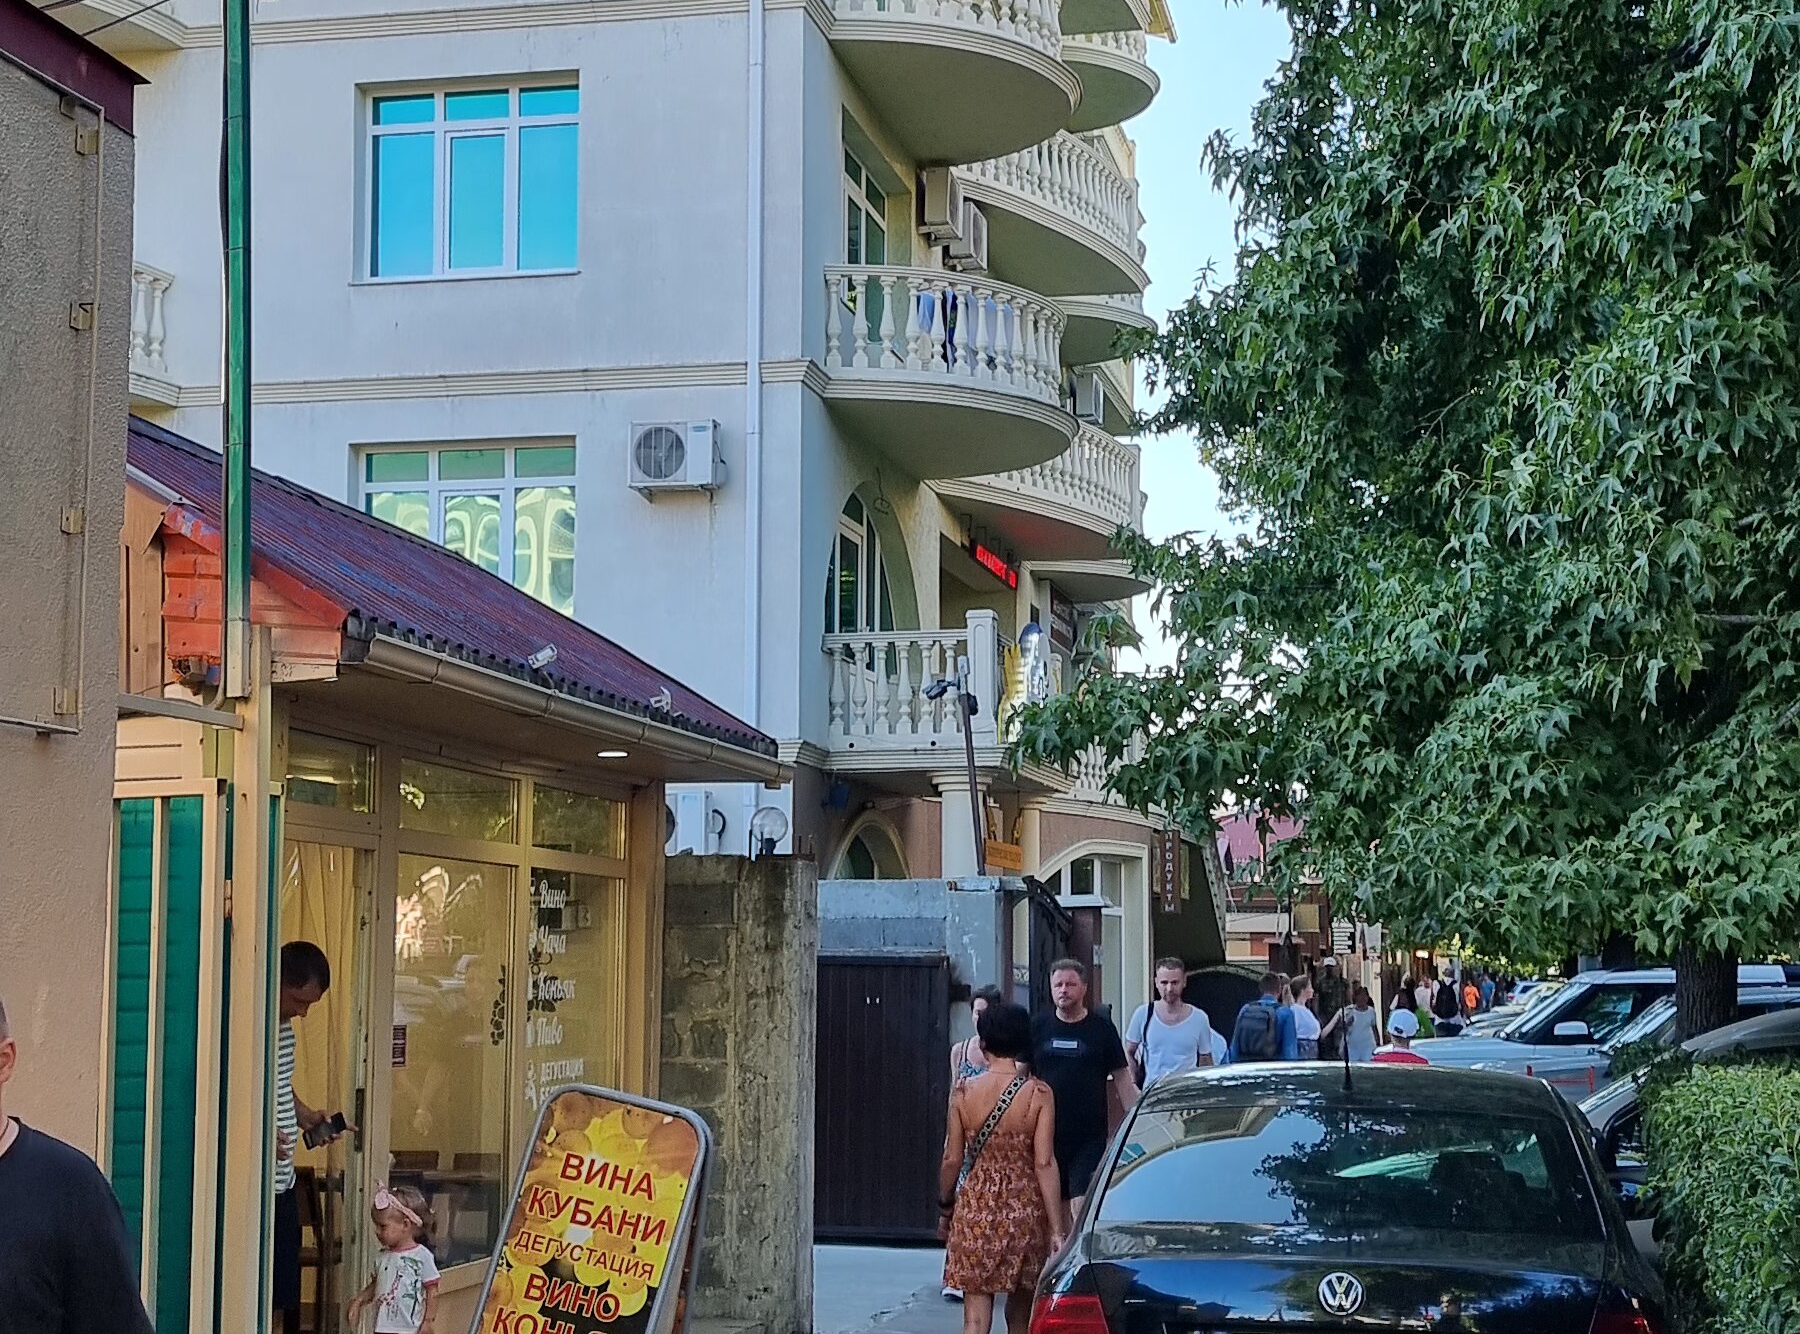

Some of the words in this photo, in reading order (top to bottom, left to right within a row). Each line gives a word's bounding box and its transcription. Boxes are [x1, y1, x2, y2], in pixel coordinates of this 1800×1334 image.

[540, 880, 566, 908] Вино
[1165, 831, 1175, 912] ПРОДУКТЫ
[538, 925, 566, 954] Чача
[537, 1016, 563, 1046] Пиво
[560, 1152, 655, 1201] ВИНА
[528, 1186, 667, 1246] КУБАНИ
[514, 1230, 655, 1281] ДЕГУСТАЦИЯ
[523, 1273, 621, 1322] ВИНО
